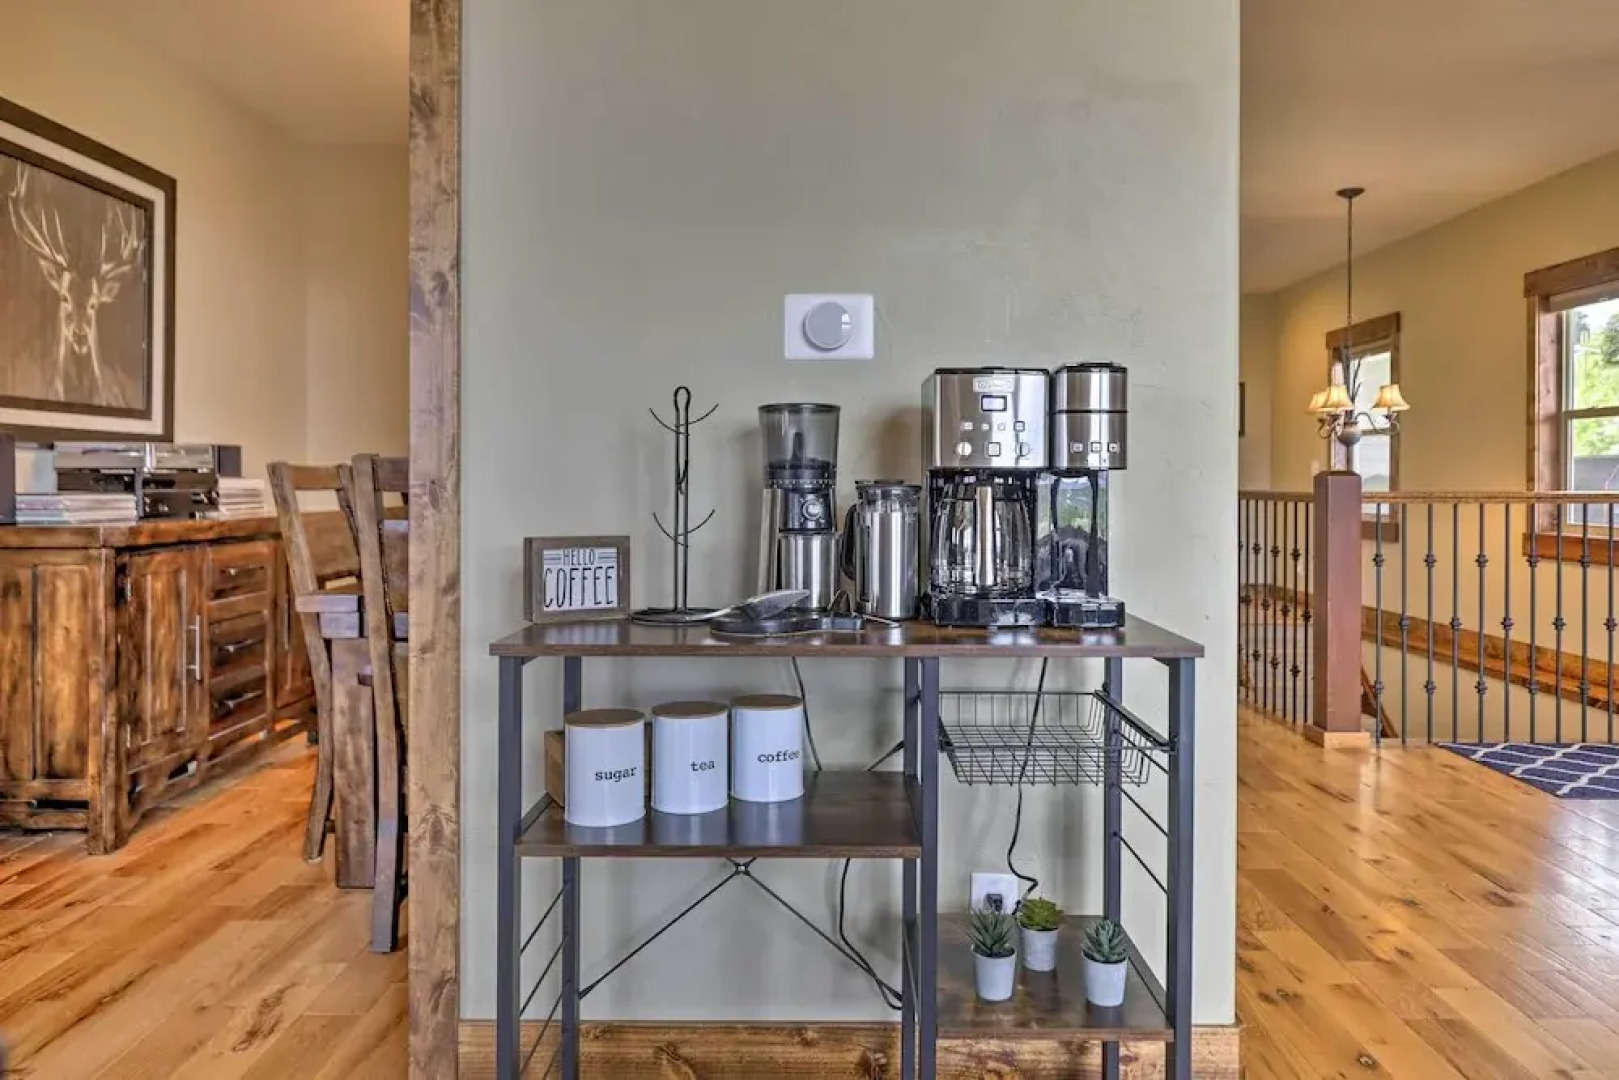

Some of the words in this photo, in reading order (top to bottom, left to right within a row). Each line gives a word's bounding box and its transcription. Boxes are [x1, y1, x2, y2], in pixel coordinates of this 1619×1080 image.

[562, 548, 595, 566] HELLO
[543, 565, 615, 608] COFFEE
[757, 749, 800, 763] coffee
[595, 766, 637, 782] sugar
[690, 760, 715, 772] tea
